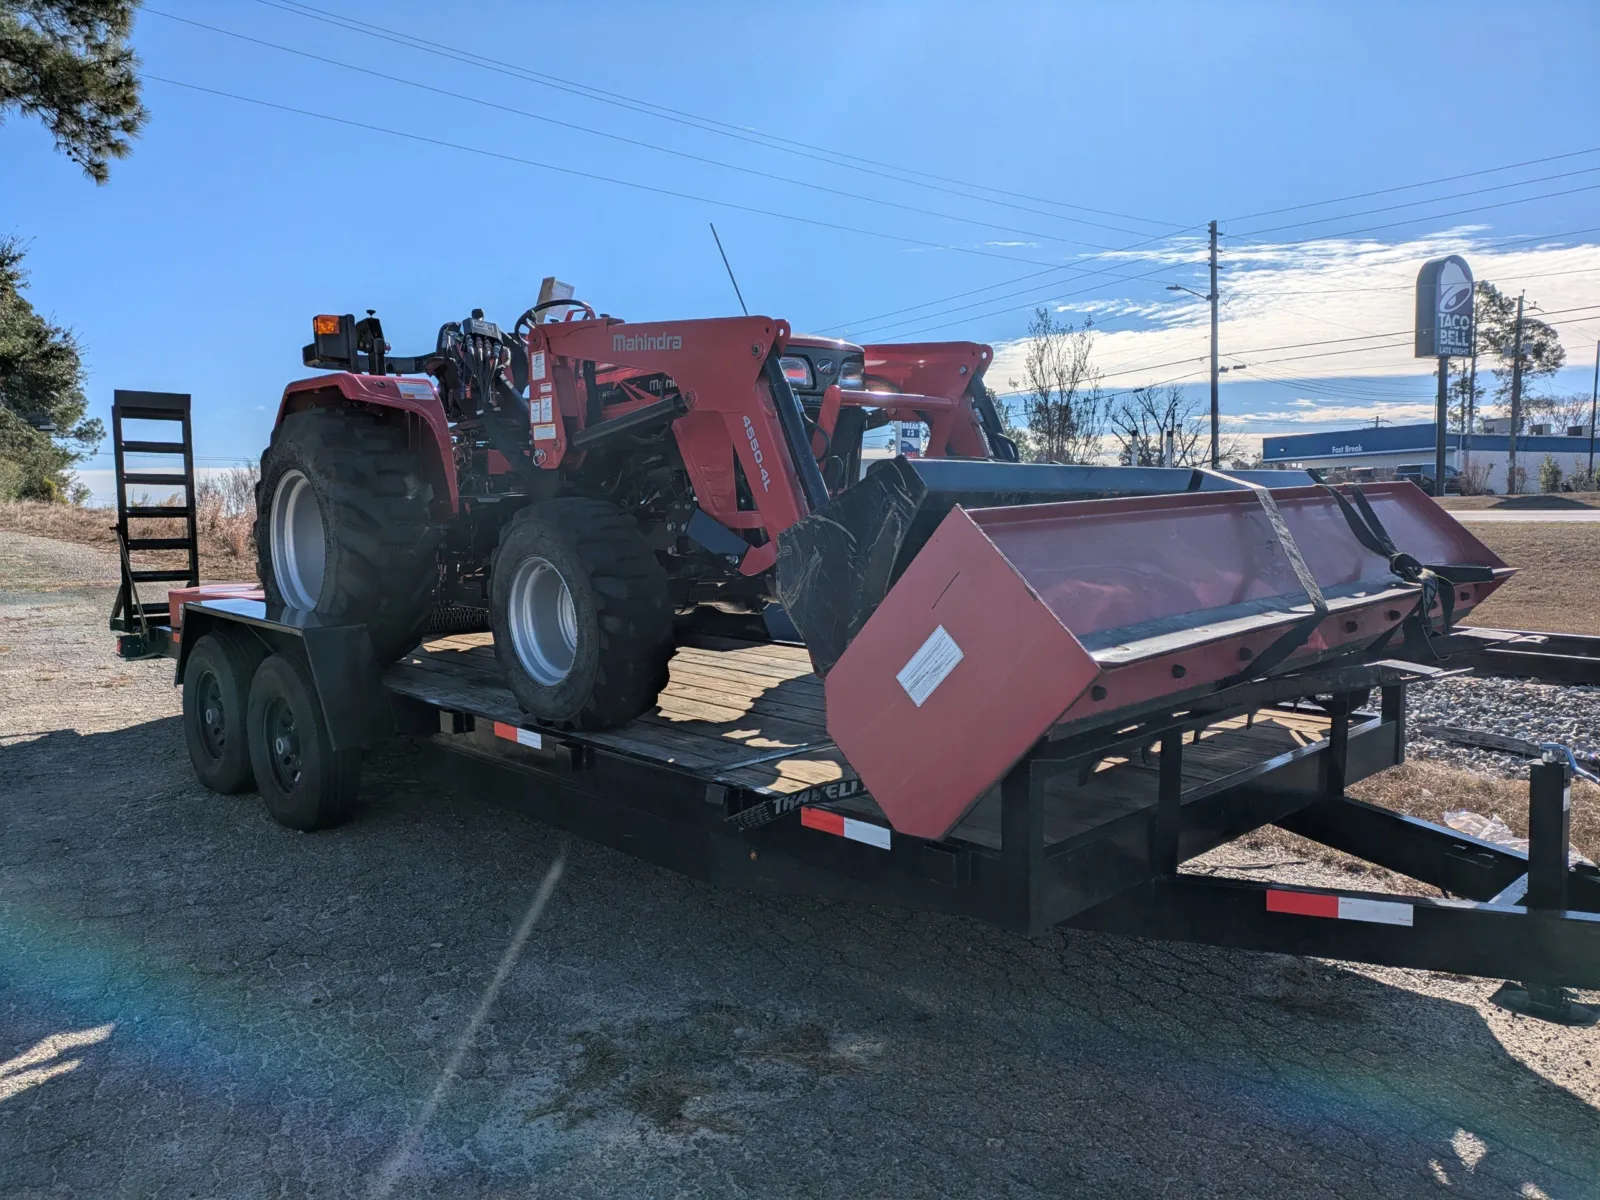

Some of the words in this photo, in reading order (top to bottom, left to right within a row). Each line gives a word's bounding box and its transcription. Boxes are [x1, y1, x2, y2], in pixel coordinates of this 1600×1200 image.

[1438, 312, 1470, 330] TACO
[613, 332, 682, 352] Mahindra
[1440, 329, 1469, 346] BELL
[1439, 346, 1452, 354] LATE
[1452, 347, 1469, 355] NIGHT
[743, 415, 771, 493] 4550-4L
[1344, 444, 1363, 452] Break
